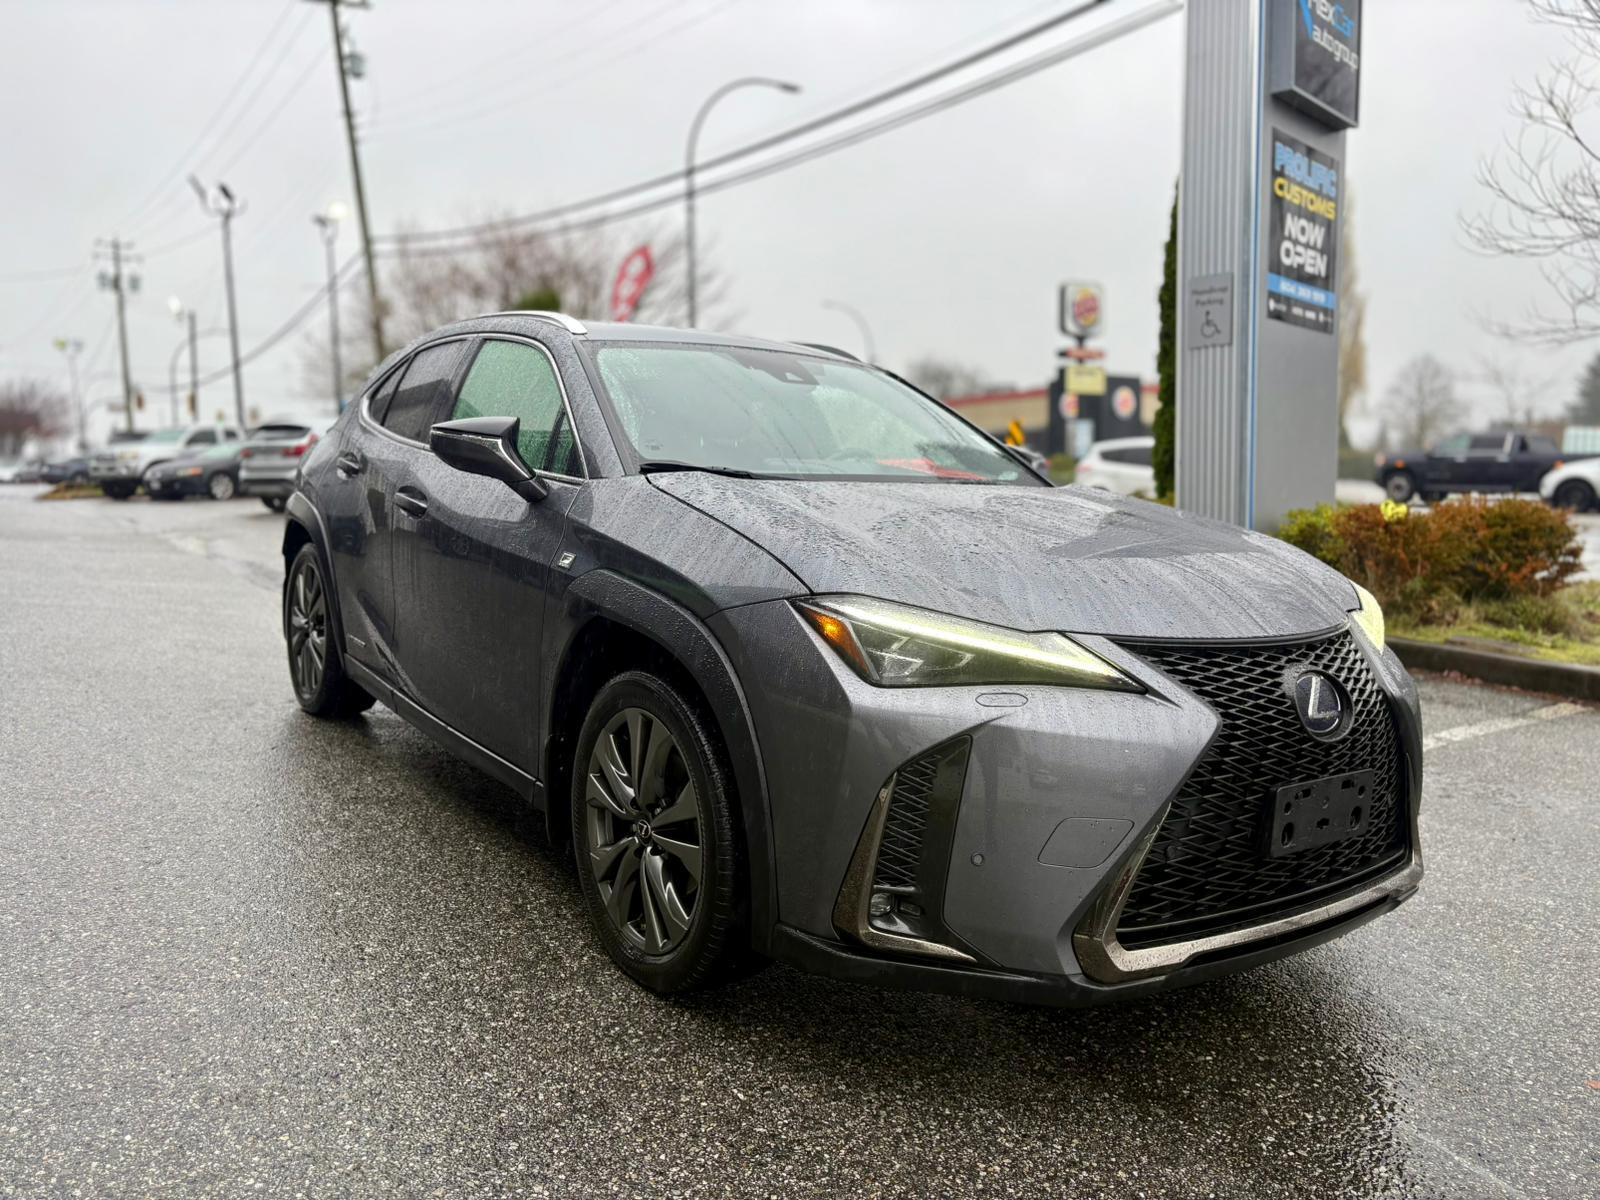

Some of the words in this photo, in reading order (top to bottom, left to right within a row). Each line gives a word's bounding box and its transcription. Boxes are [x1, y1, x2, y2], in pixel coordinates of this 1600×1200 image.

[1274, 177, 1336, 221] CUSTOMS
[1284, 212, 1325, 249] NOW
[1280, 239, 1328, 278] OPEN
